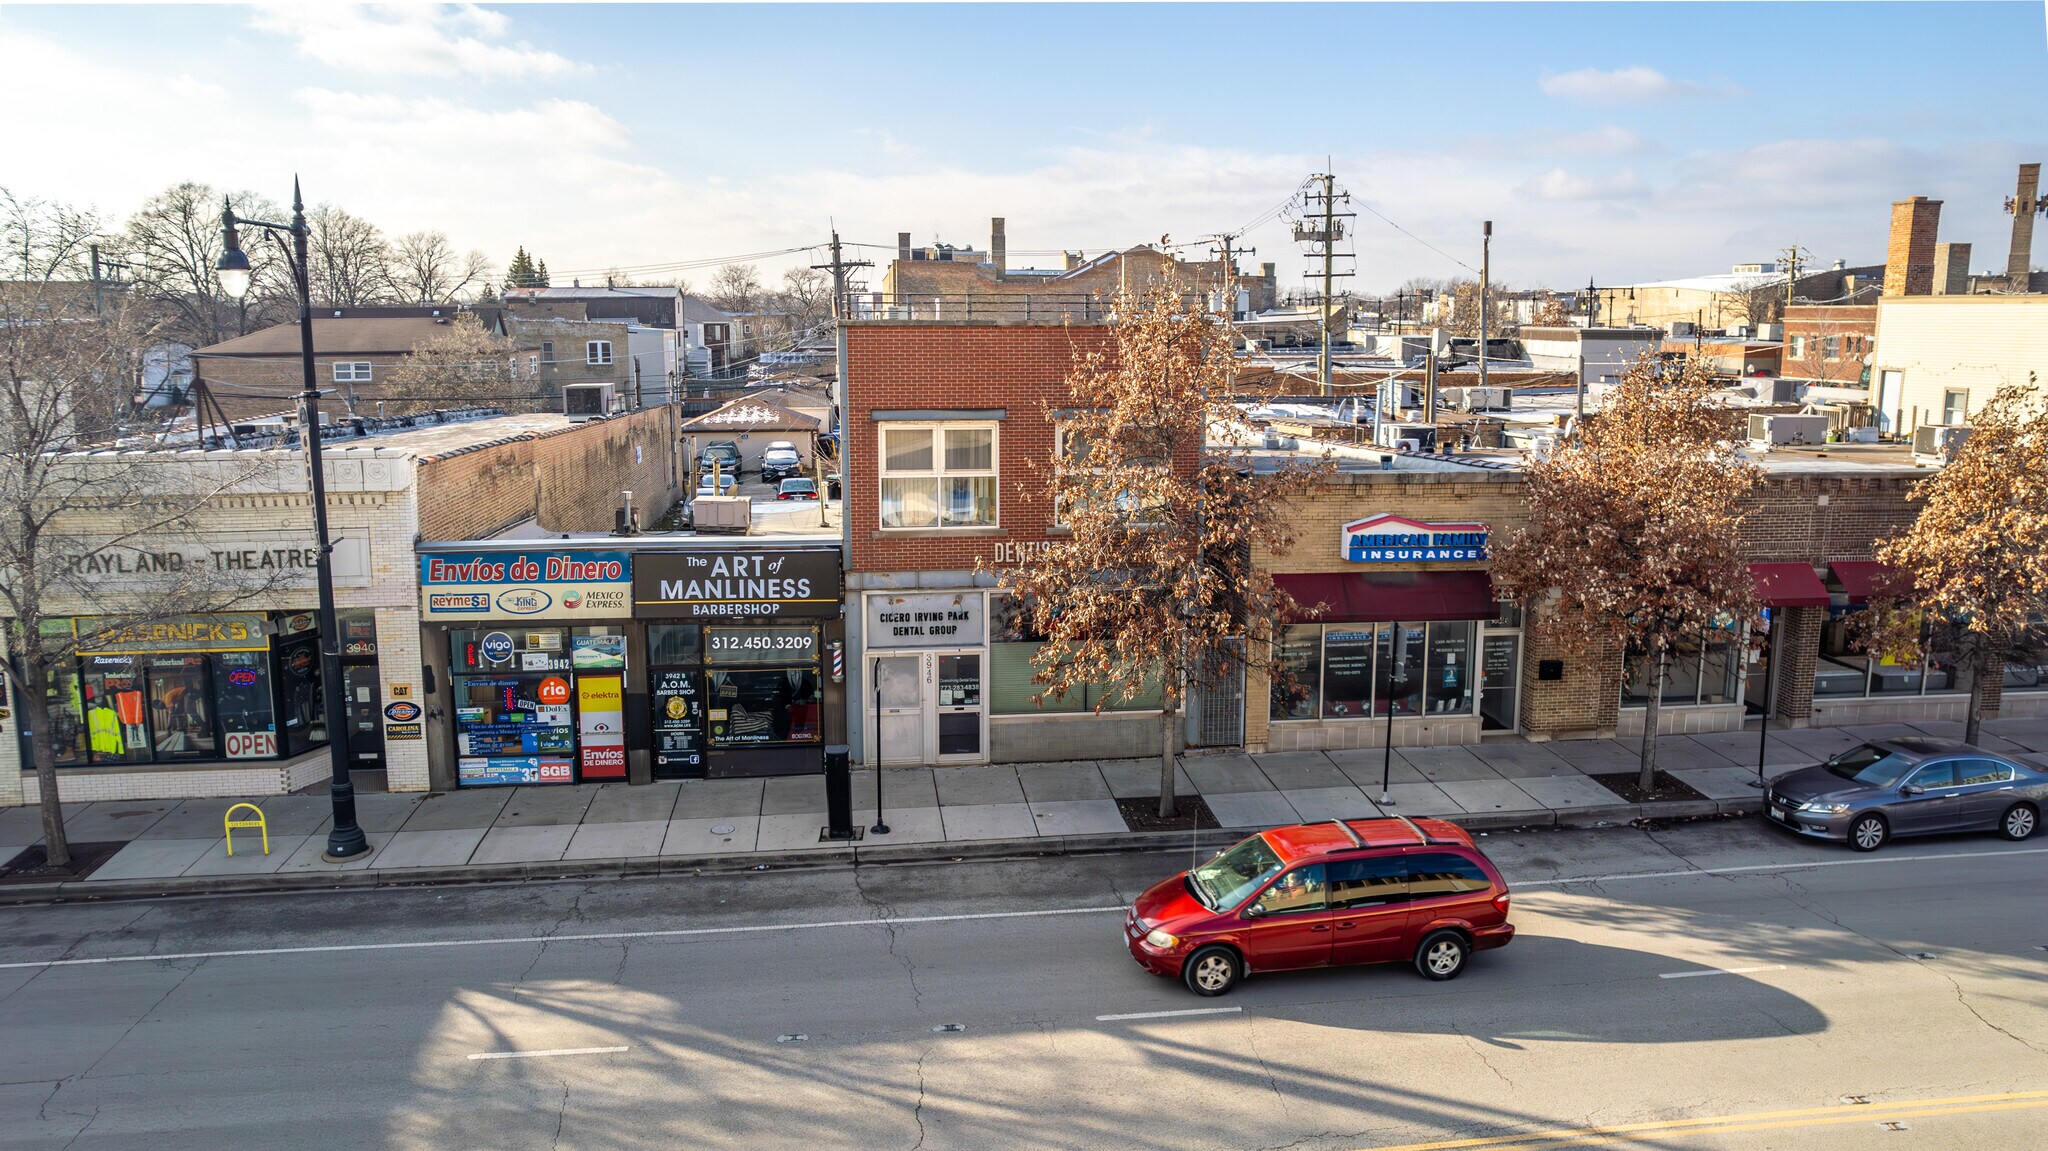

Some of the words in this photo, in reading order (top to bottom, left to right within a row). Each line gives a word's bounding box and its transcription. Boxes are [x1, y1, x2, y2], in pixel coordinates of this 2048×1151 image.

[1350, 533, 1429, 547] AMERICAN
[1433, 533, 1489, 546] FAMILY
[210, 549, 318, 571] THEATRE
[1362, 550, 1477, 559] INSURANCE
[429, 558, 505, 582] Envíos
[510, 556, 539, 581] de
[545, 556, 622, 580] Dinero
[687, 557, 707, 567] The
[711, 556, 764, 577] ART
[768, 557, 785, 574] of
[660, 578, 811, 599] MANLINESS
[586, 591, 624, 600] MEXICO
[514, 597, 538, 607] KING
[693, 603, 780, 615] BARBERSHOP
[880, 613, 910, 623] CICERO
[915, 612, 943, 622] IRVING
[948, 611, 969, 621] PARK
[893, 626, 924, 636] DENTAL
[929, 625, 957, 635] GROUP
[346, 643, 376, 653] 3940
[485, 639, 511, 651] vigo
[576, 638, 616, 646] GUATEMALA
[712, 636, 812, 650] 312.450.3209
[549, 659, 570, 670] 3942
[228, 671, 257, 683] OPEN
[543, 681, 566, 697] ria
[661, 680, 691, 689] A.O.M.
[393, 686, 409, 696] CAT
[590, 691, 620, 699] elektra
[519, 701, 535, 710] OPEN
[545, 705, 568, 713] DolEx
[227, 734, 278, 756] OPEN
[583, 748, 623, 760] Envíos
[540, 765, 571, 777] 6GB
